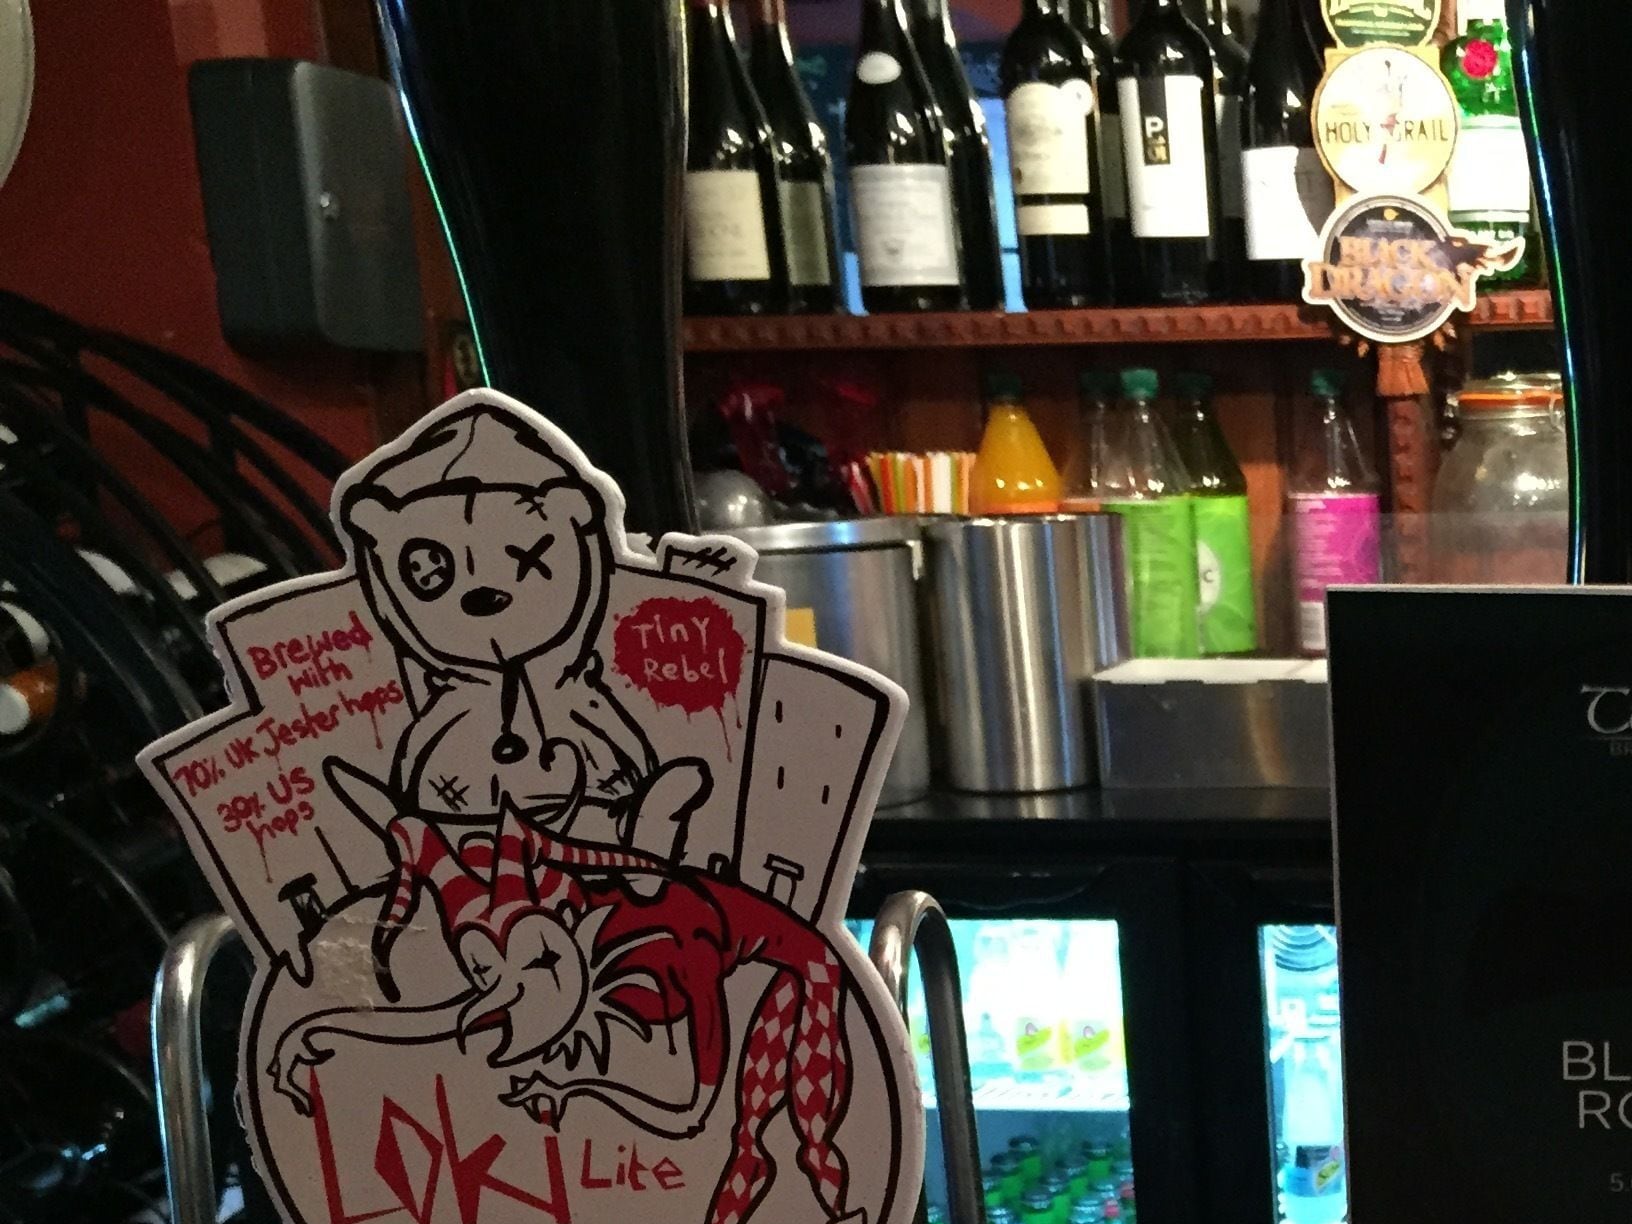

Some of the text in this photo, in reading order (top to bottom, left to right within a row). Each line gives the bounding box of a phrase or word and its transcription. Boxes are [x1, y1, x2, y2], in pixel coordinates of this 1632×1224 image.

[1325, 121, 1371, 144] HOLY
[247, 610, 373, 680] Brewed
[643, 647, 729, 687] Rebel
[288, 656, 353, 696] with
[172, 755, 226, 797] 70%
[255, 702, 340, 757] Jester
[216, 766, 315, 833] 30% US
[579, 1137, 687, 1193] Lite
